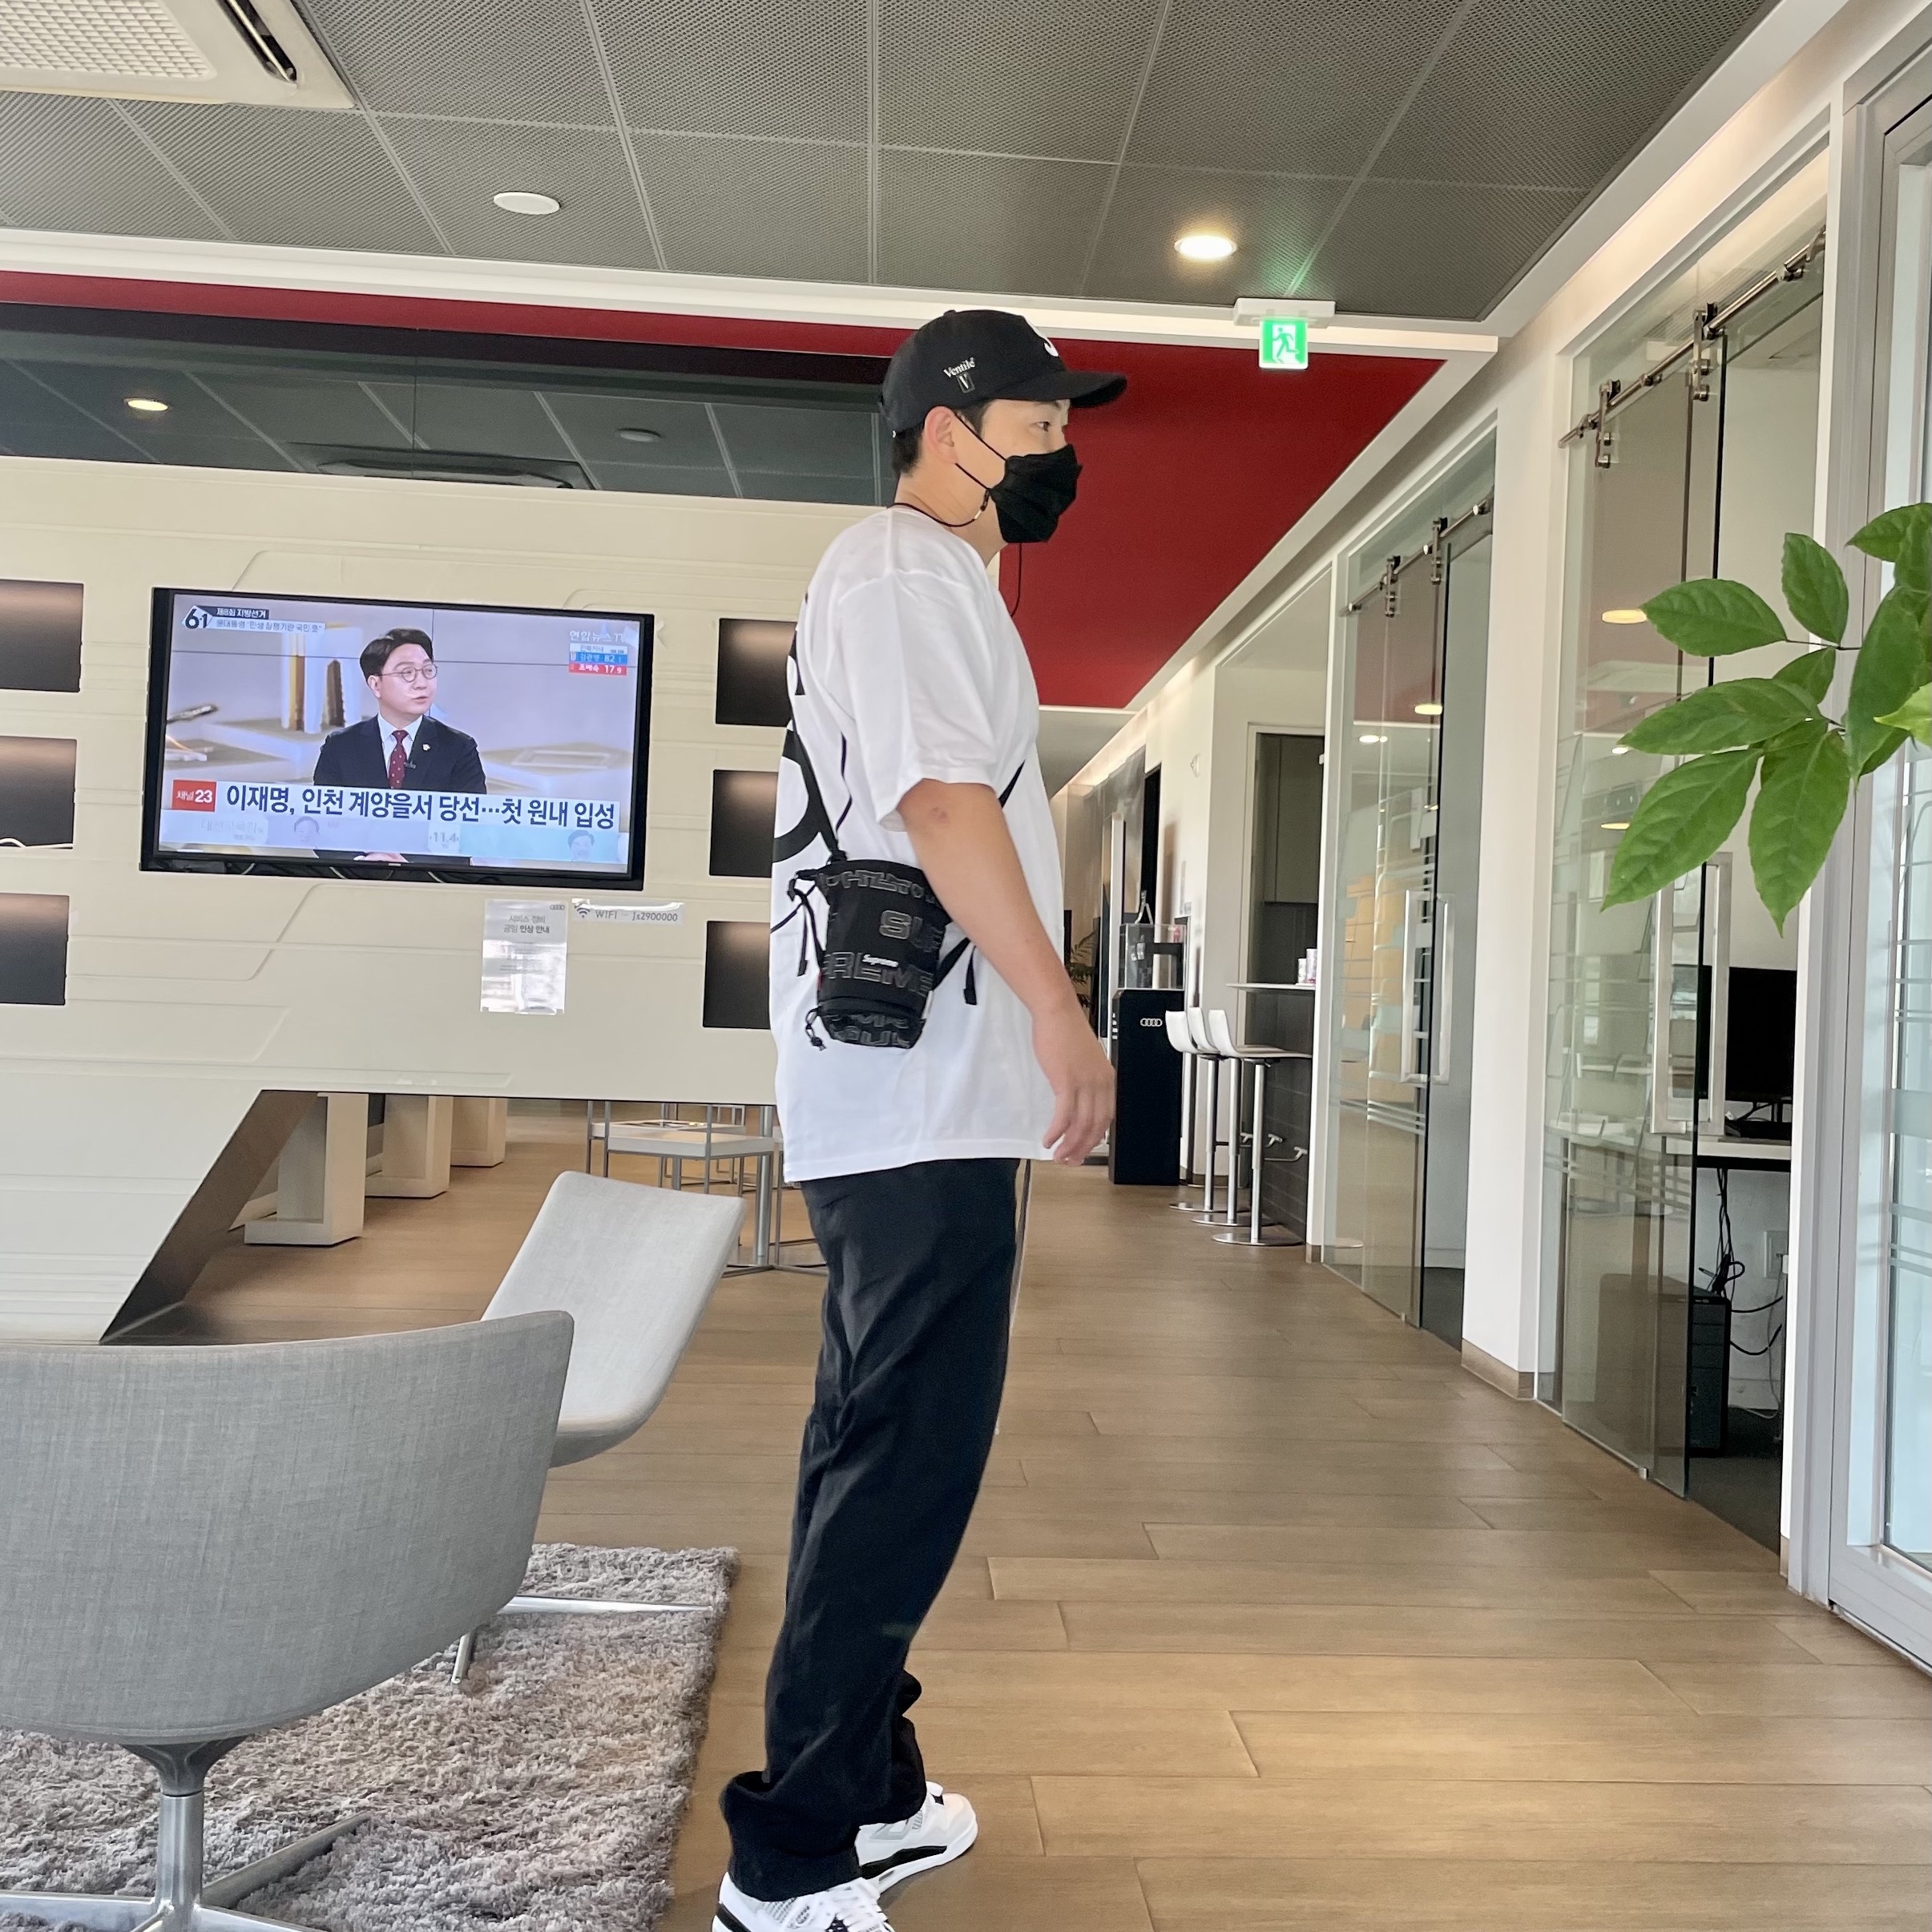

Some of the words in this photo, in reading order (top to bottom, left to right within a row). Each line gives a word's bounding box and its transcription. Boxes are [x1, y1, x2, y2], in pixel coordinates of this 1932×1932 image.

[236, 608, 266, 618] 지방선거
[195, 789, 213, 803] 23
[227, 784, 295, 816] 이재명,
[302, 789, 344, 816] 인천
[349, 789, 433, 821] 계양을서
[527, 800, 568, 827] 원내
[575, 802, 615, 829] 입성
[595, 910, 618, 919] WIFI
[519, 925, 534, 934] 인상
[535, 926, 551, 934] 안내
